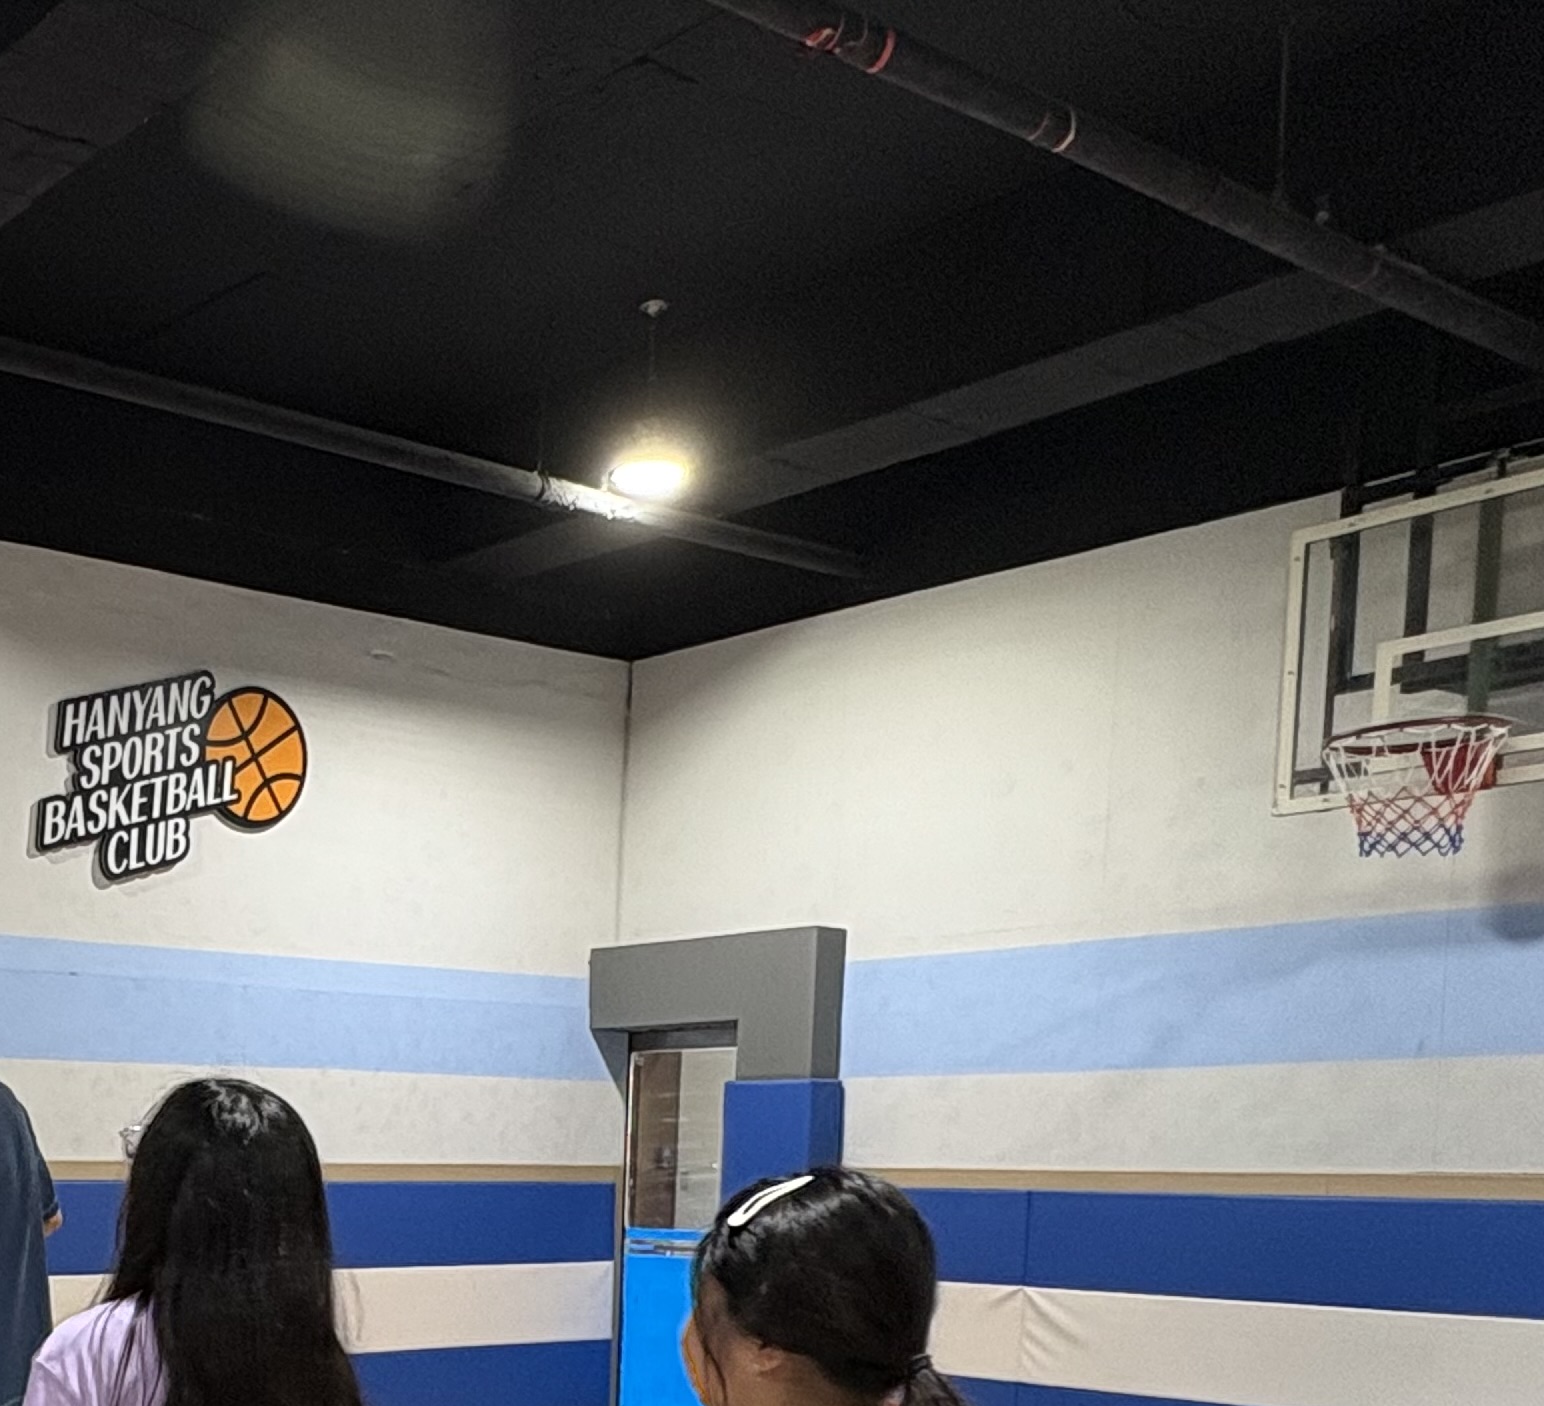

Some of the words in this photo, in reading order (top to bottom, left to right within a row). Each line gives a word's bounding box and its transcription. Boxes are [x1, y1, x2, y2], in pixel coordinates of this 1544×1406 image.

[62, 675, 212, 748] HANYANG
[80, 723, 201, 790] SPORTS
[43, 760, 239, 846] BASKETBALL
[107, 817, 187, 875] CLUB
